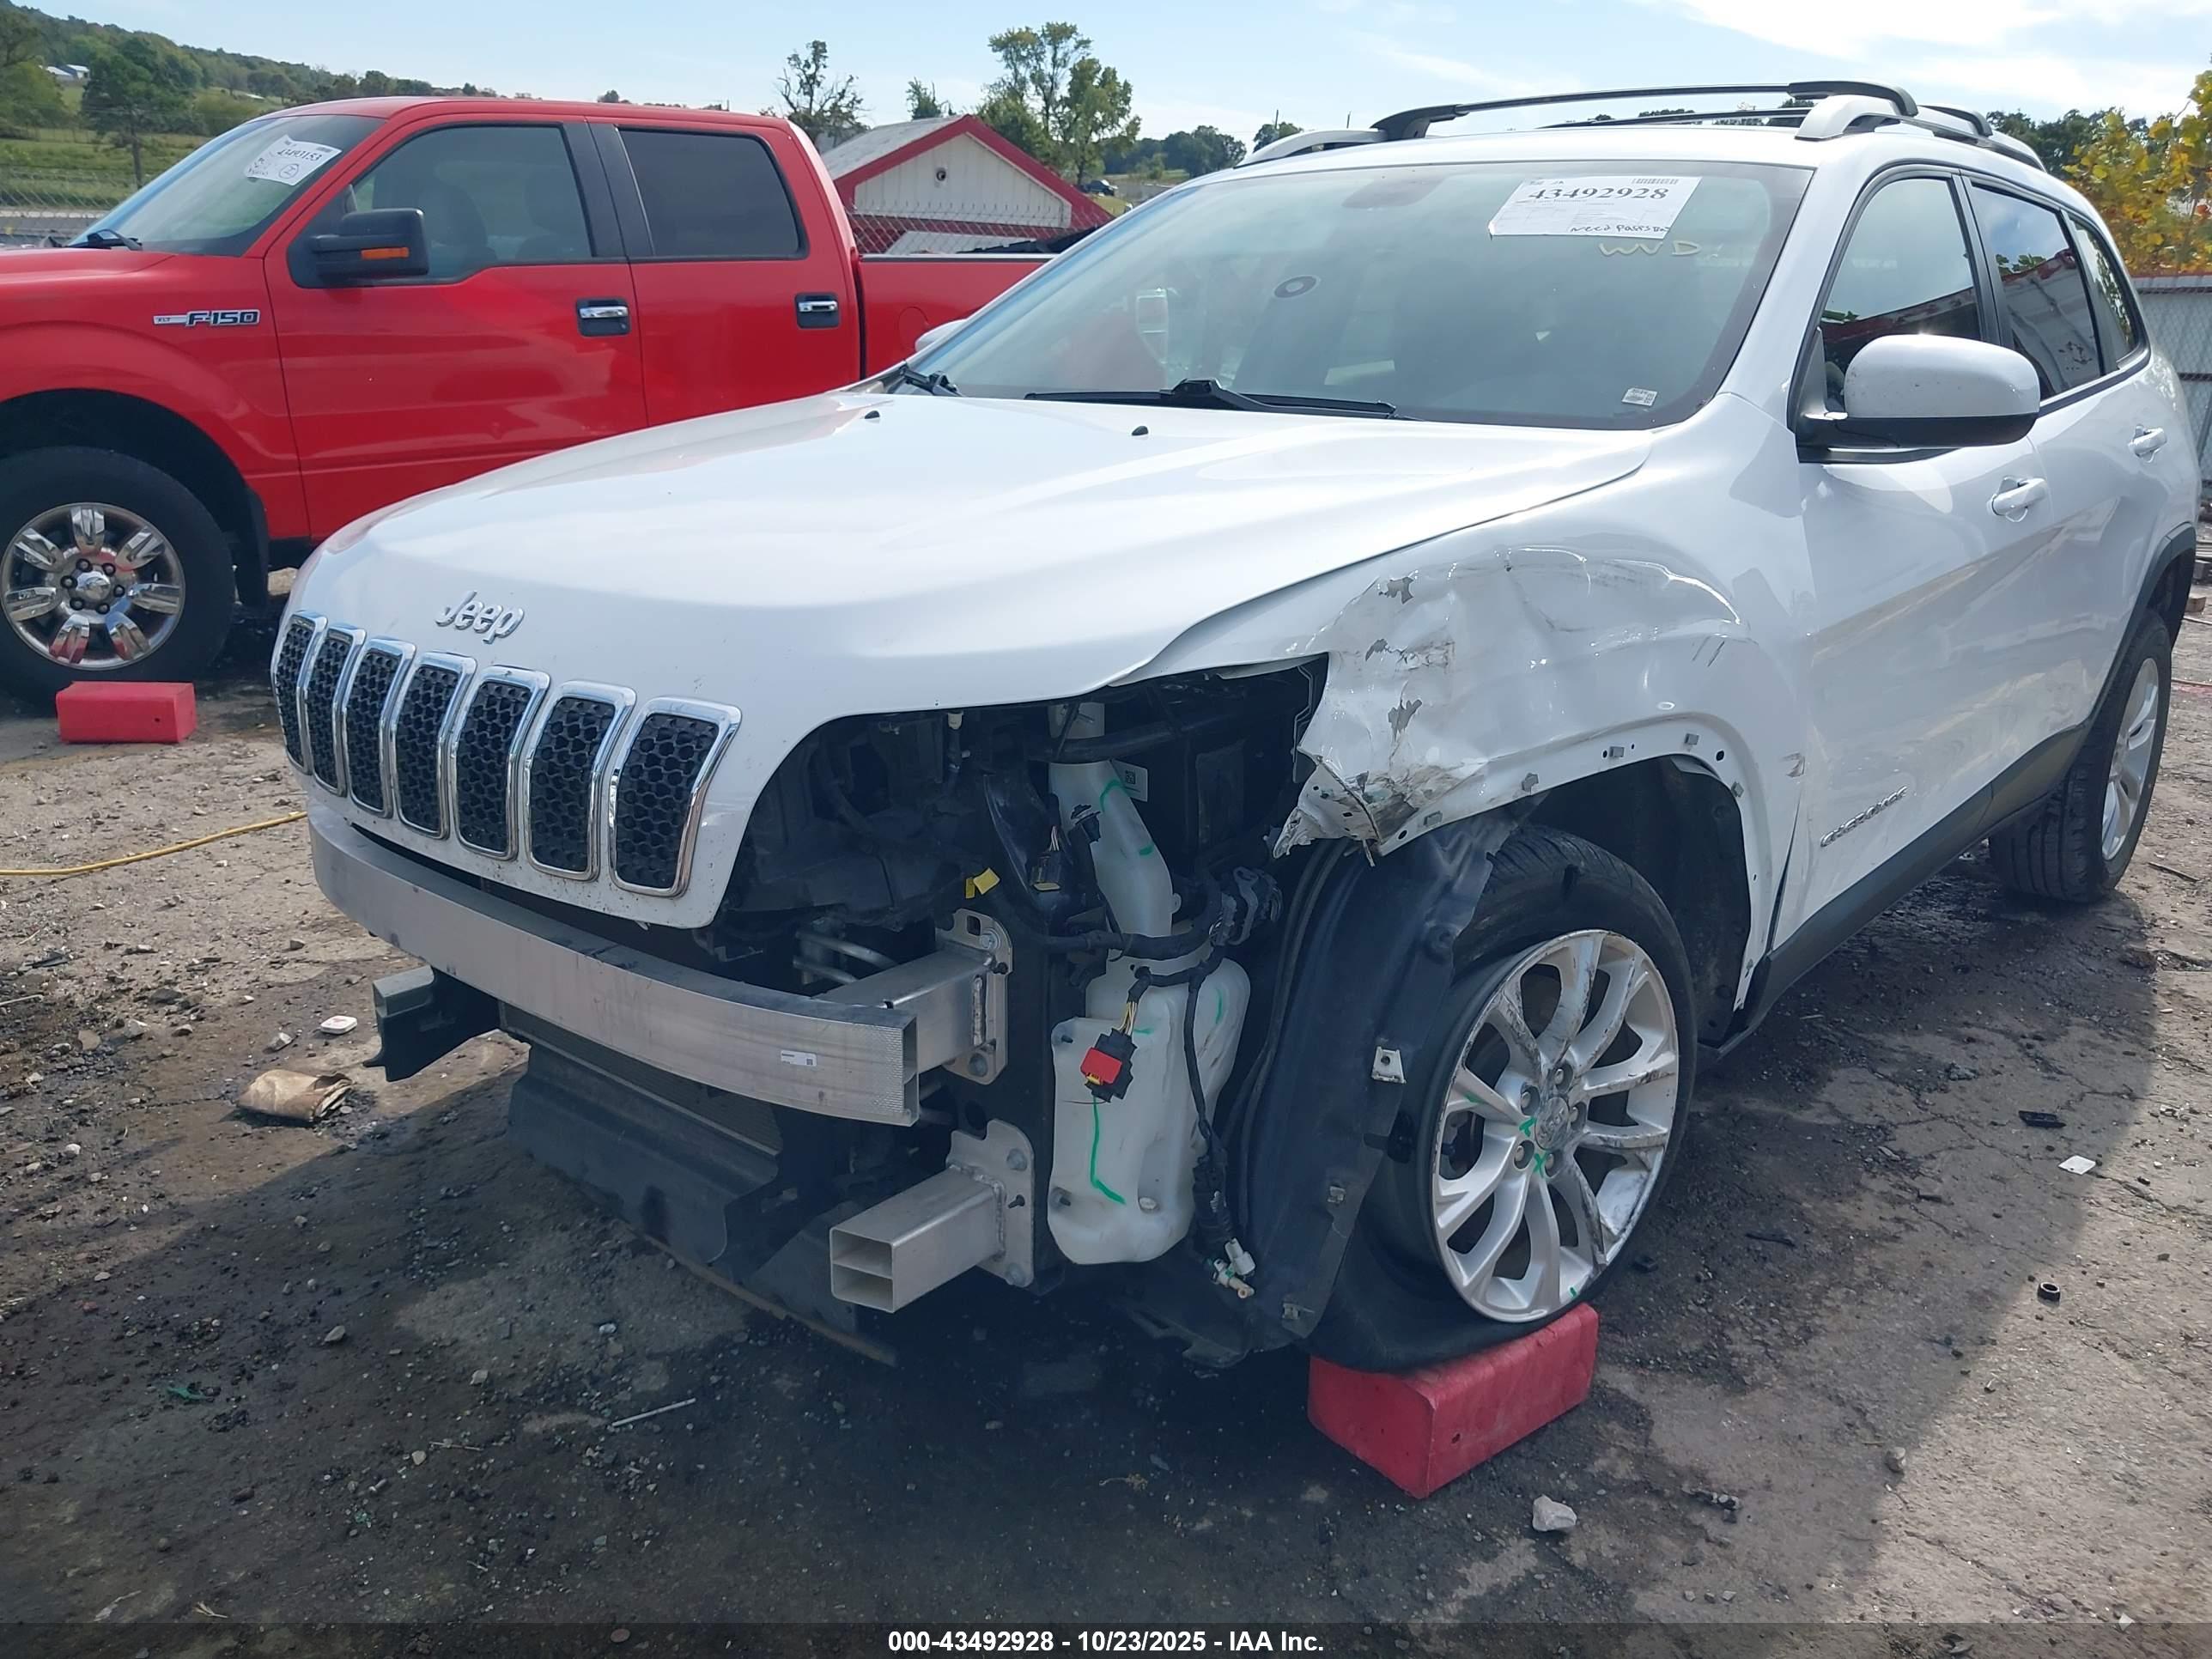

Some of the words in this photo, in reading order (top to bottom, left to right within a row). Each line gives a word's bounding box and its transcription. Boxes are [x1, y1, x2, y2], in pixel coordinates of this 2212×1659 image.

[1528, 186, 1669, 200] 43492928
[187, 309, 260, 326] F-150
[434, 590, 525, 645] Jeep
